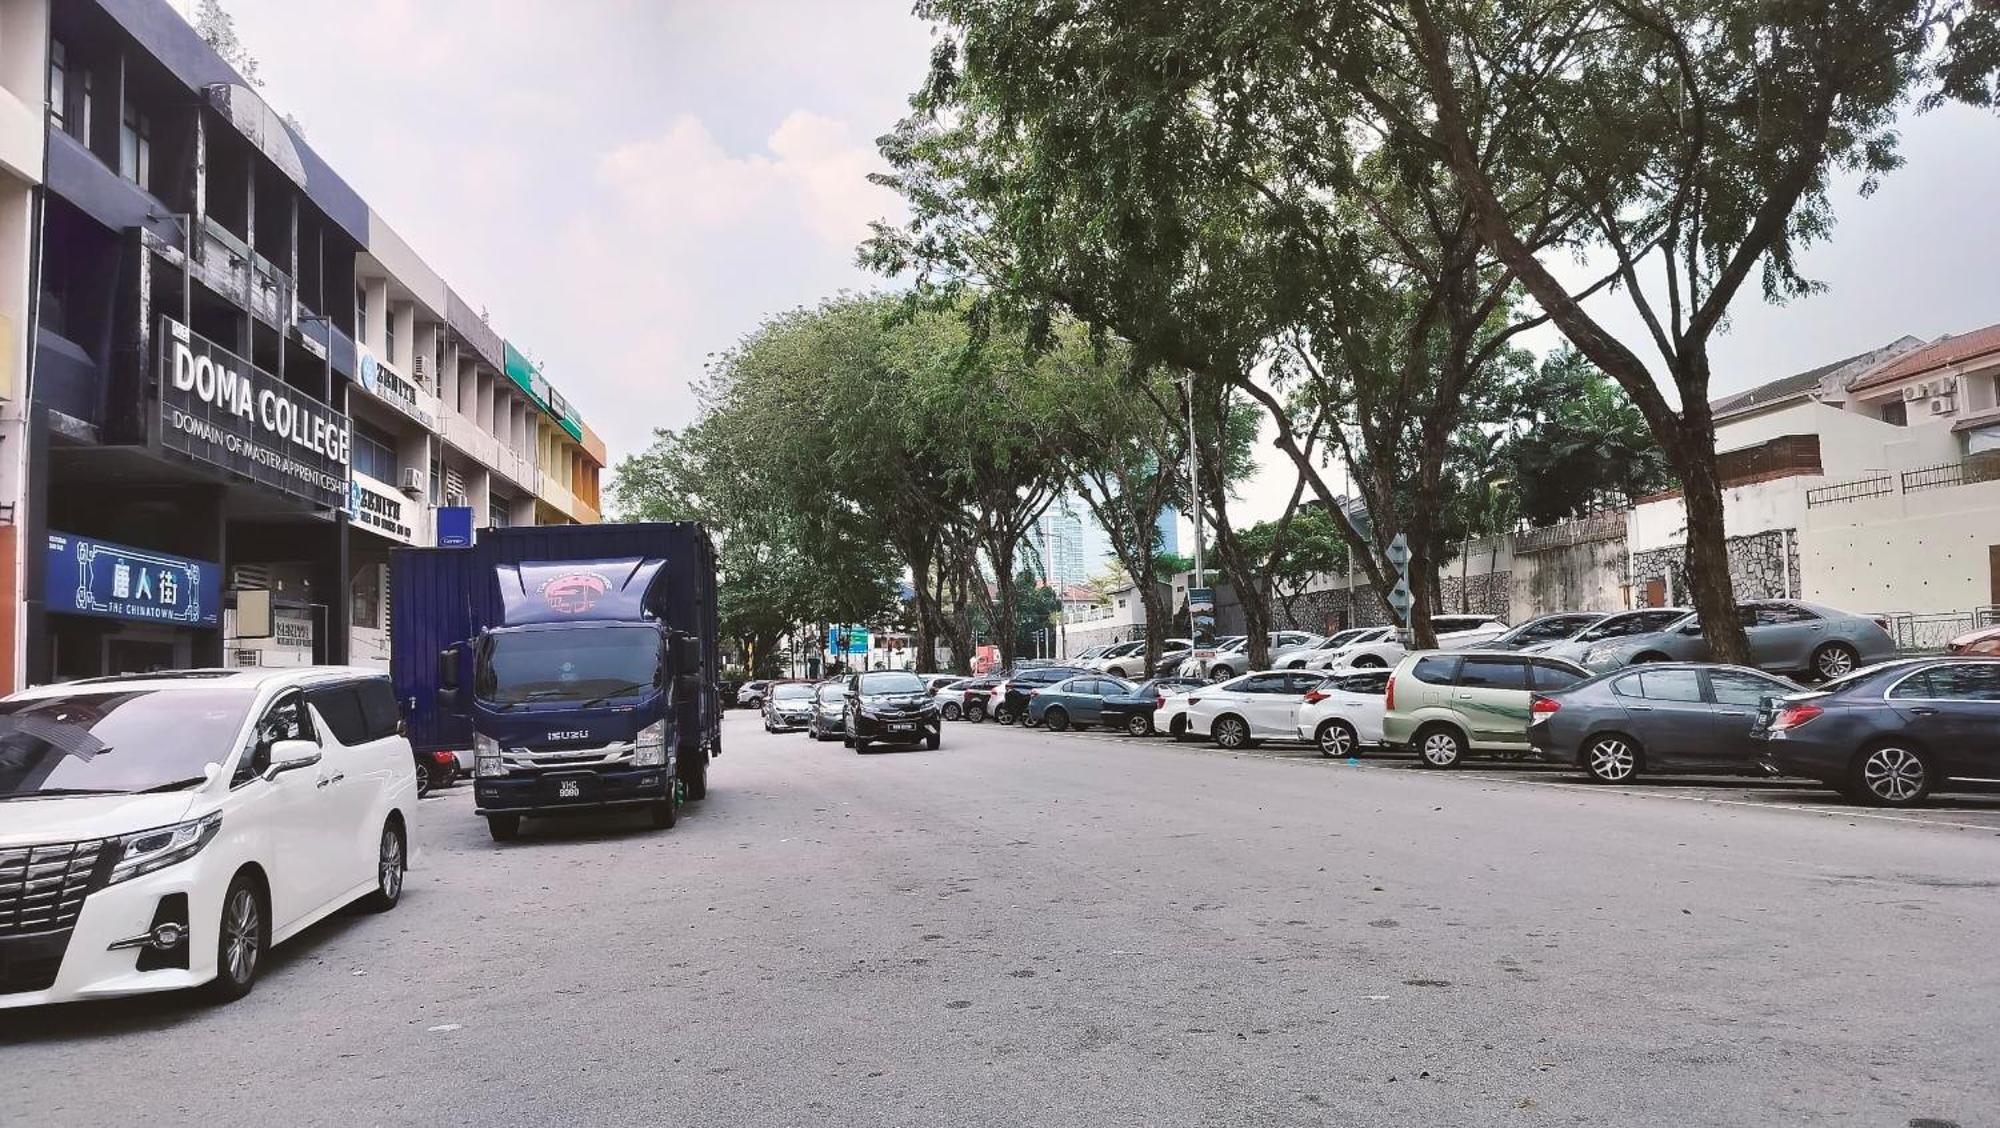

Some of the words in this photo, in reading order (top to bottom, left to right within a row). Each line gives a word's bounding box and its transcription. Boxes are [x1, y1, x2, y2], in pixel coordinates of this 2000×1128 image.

[174, 341, 254, 422] DOMA
[259, 389, 349, 465] COLLEGE
[174, 410, 224, 447] DOMAIN
[226, 434, 241, 453] OF
[242, 440, 281, 471] MASTER
[361, 487, 401, 521] ZENITH
[109, 602, 123, 614] THE
[126, 604, 174, 619] CHINATOWN
[548, 730, 589, 741] ISUZU
